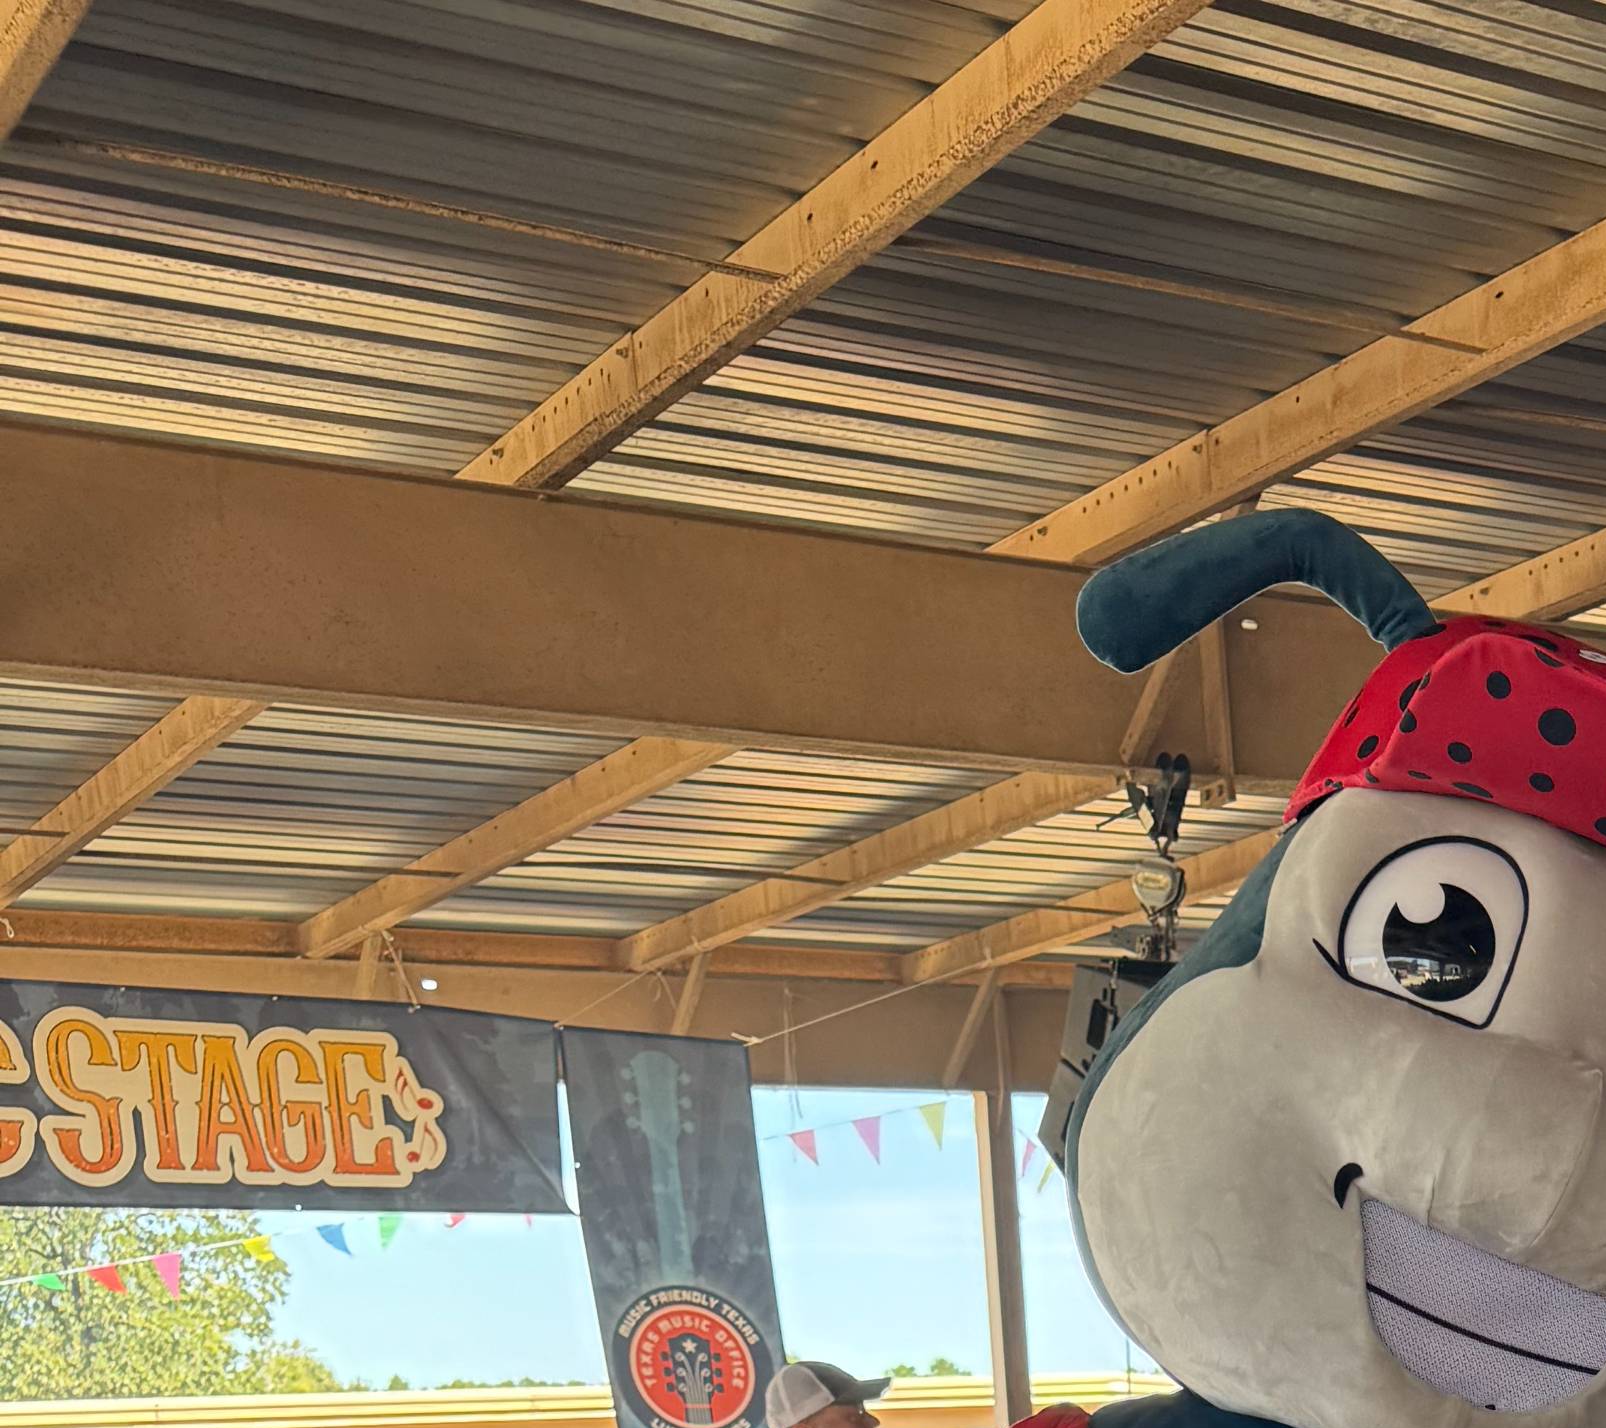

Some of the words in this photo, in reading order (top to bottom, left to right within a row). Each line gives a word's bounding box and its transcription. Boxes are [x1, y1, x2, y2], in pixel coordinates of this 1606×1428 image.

[45, 1018, 400, 1176] STAGE
[619, 1300, 651, 1339] MUSIC
[649, 1290, 720, 1308] FRIENDLY
[721, 1303, 760, 1346] TEXAS
[640, 1331, 661, 1389] TEXAS
[657, 1314, 711, 1333] MUSIC
[715, 1330, 745, 1390] OFFICE
